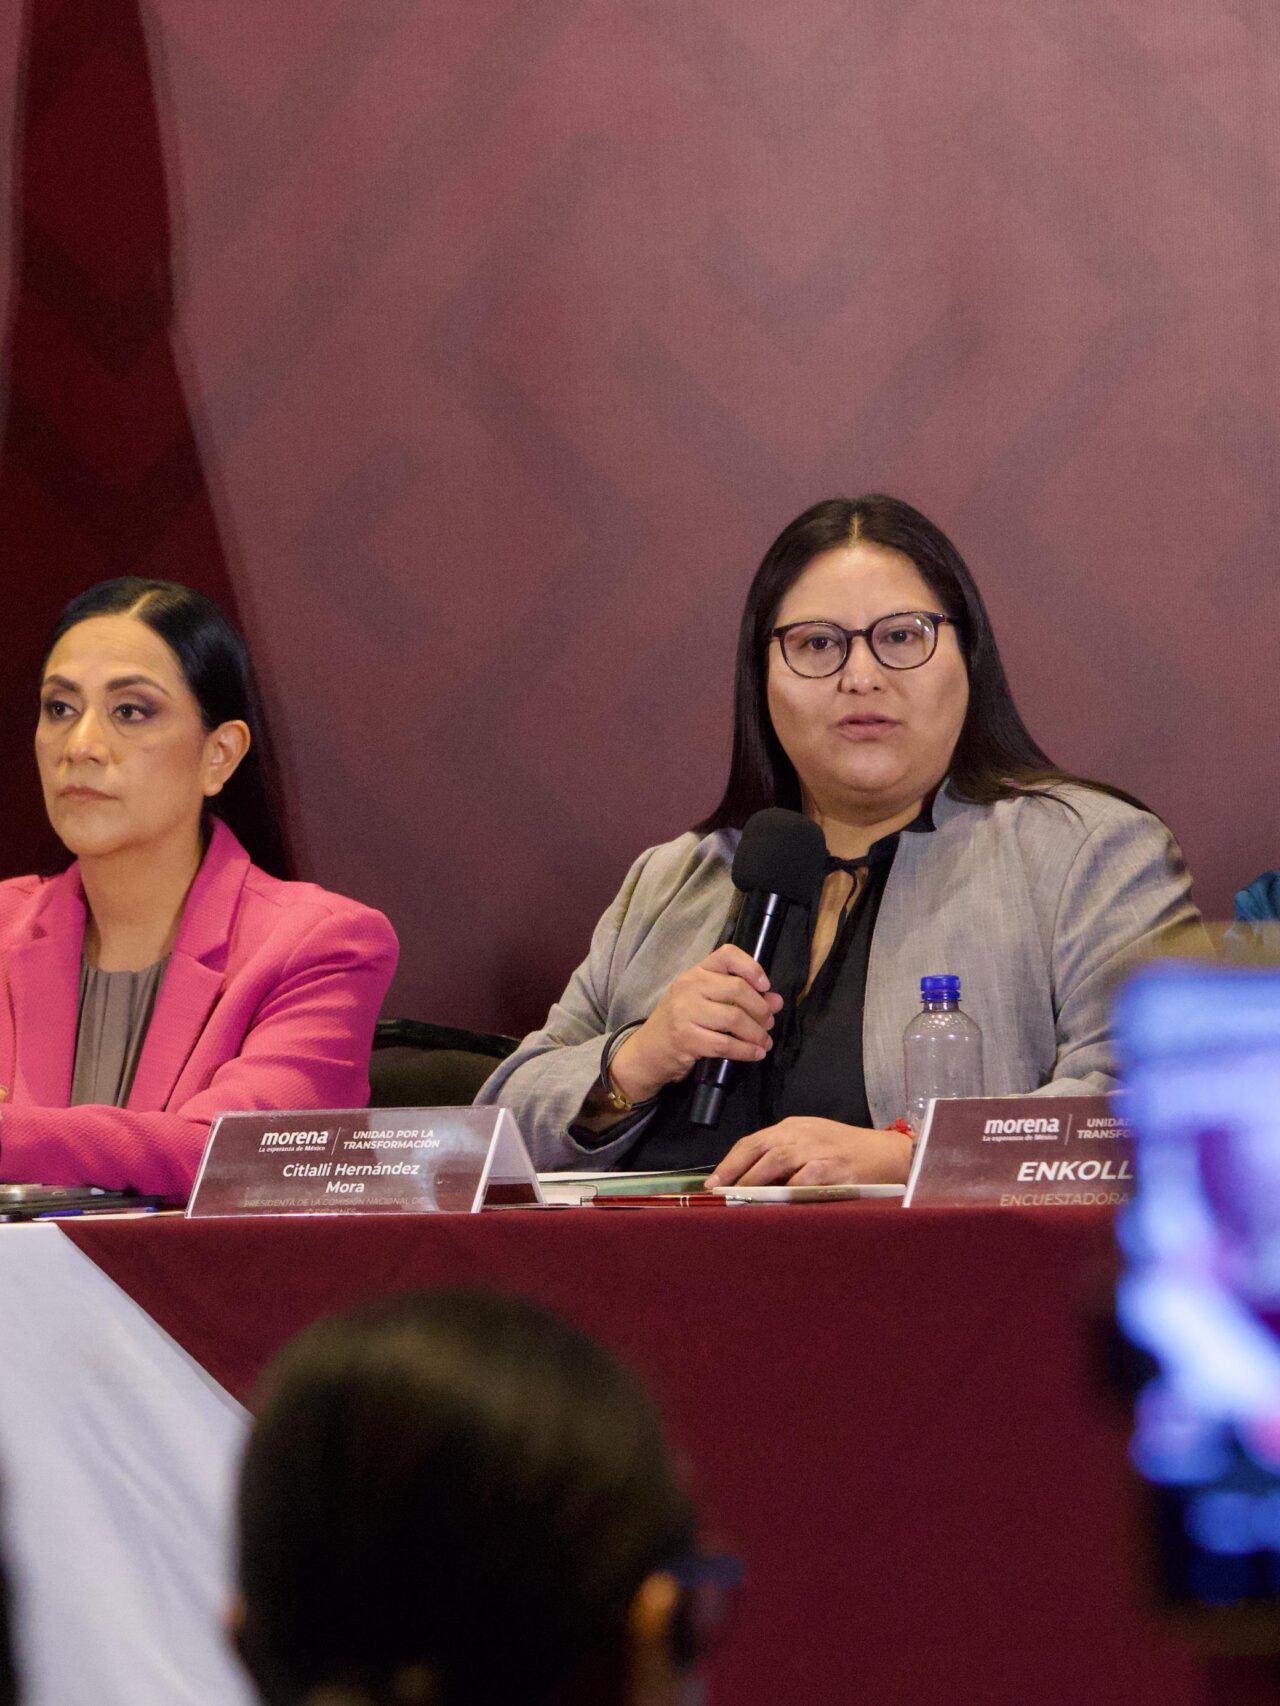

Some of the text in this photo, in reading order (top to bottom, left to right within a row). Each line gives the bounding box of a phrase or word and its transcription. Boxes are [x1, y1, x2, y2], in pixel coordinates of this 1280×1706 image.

[984, 1118, 1059, 1134] morena
[261, 1130, 328, 1145] morena
[353, 1129, 433, 1139] UNIDAD POR LA
[266, 1146, 295, 1154] esperanza
[304, 1144, 326, 1152] México
[343, 1139, 440, 1150] TRANSFORMACIÓN
[282, 1161, 420, 1177] Citlalli Hernández
[1017, 1160, 1134, 1181] ENKOLL
[325, 1181, 365, 1193] Mora
[1000, 1192, 1131, 1207] ENCUESTADORA
